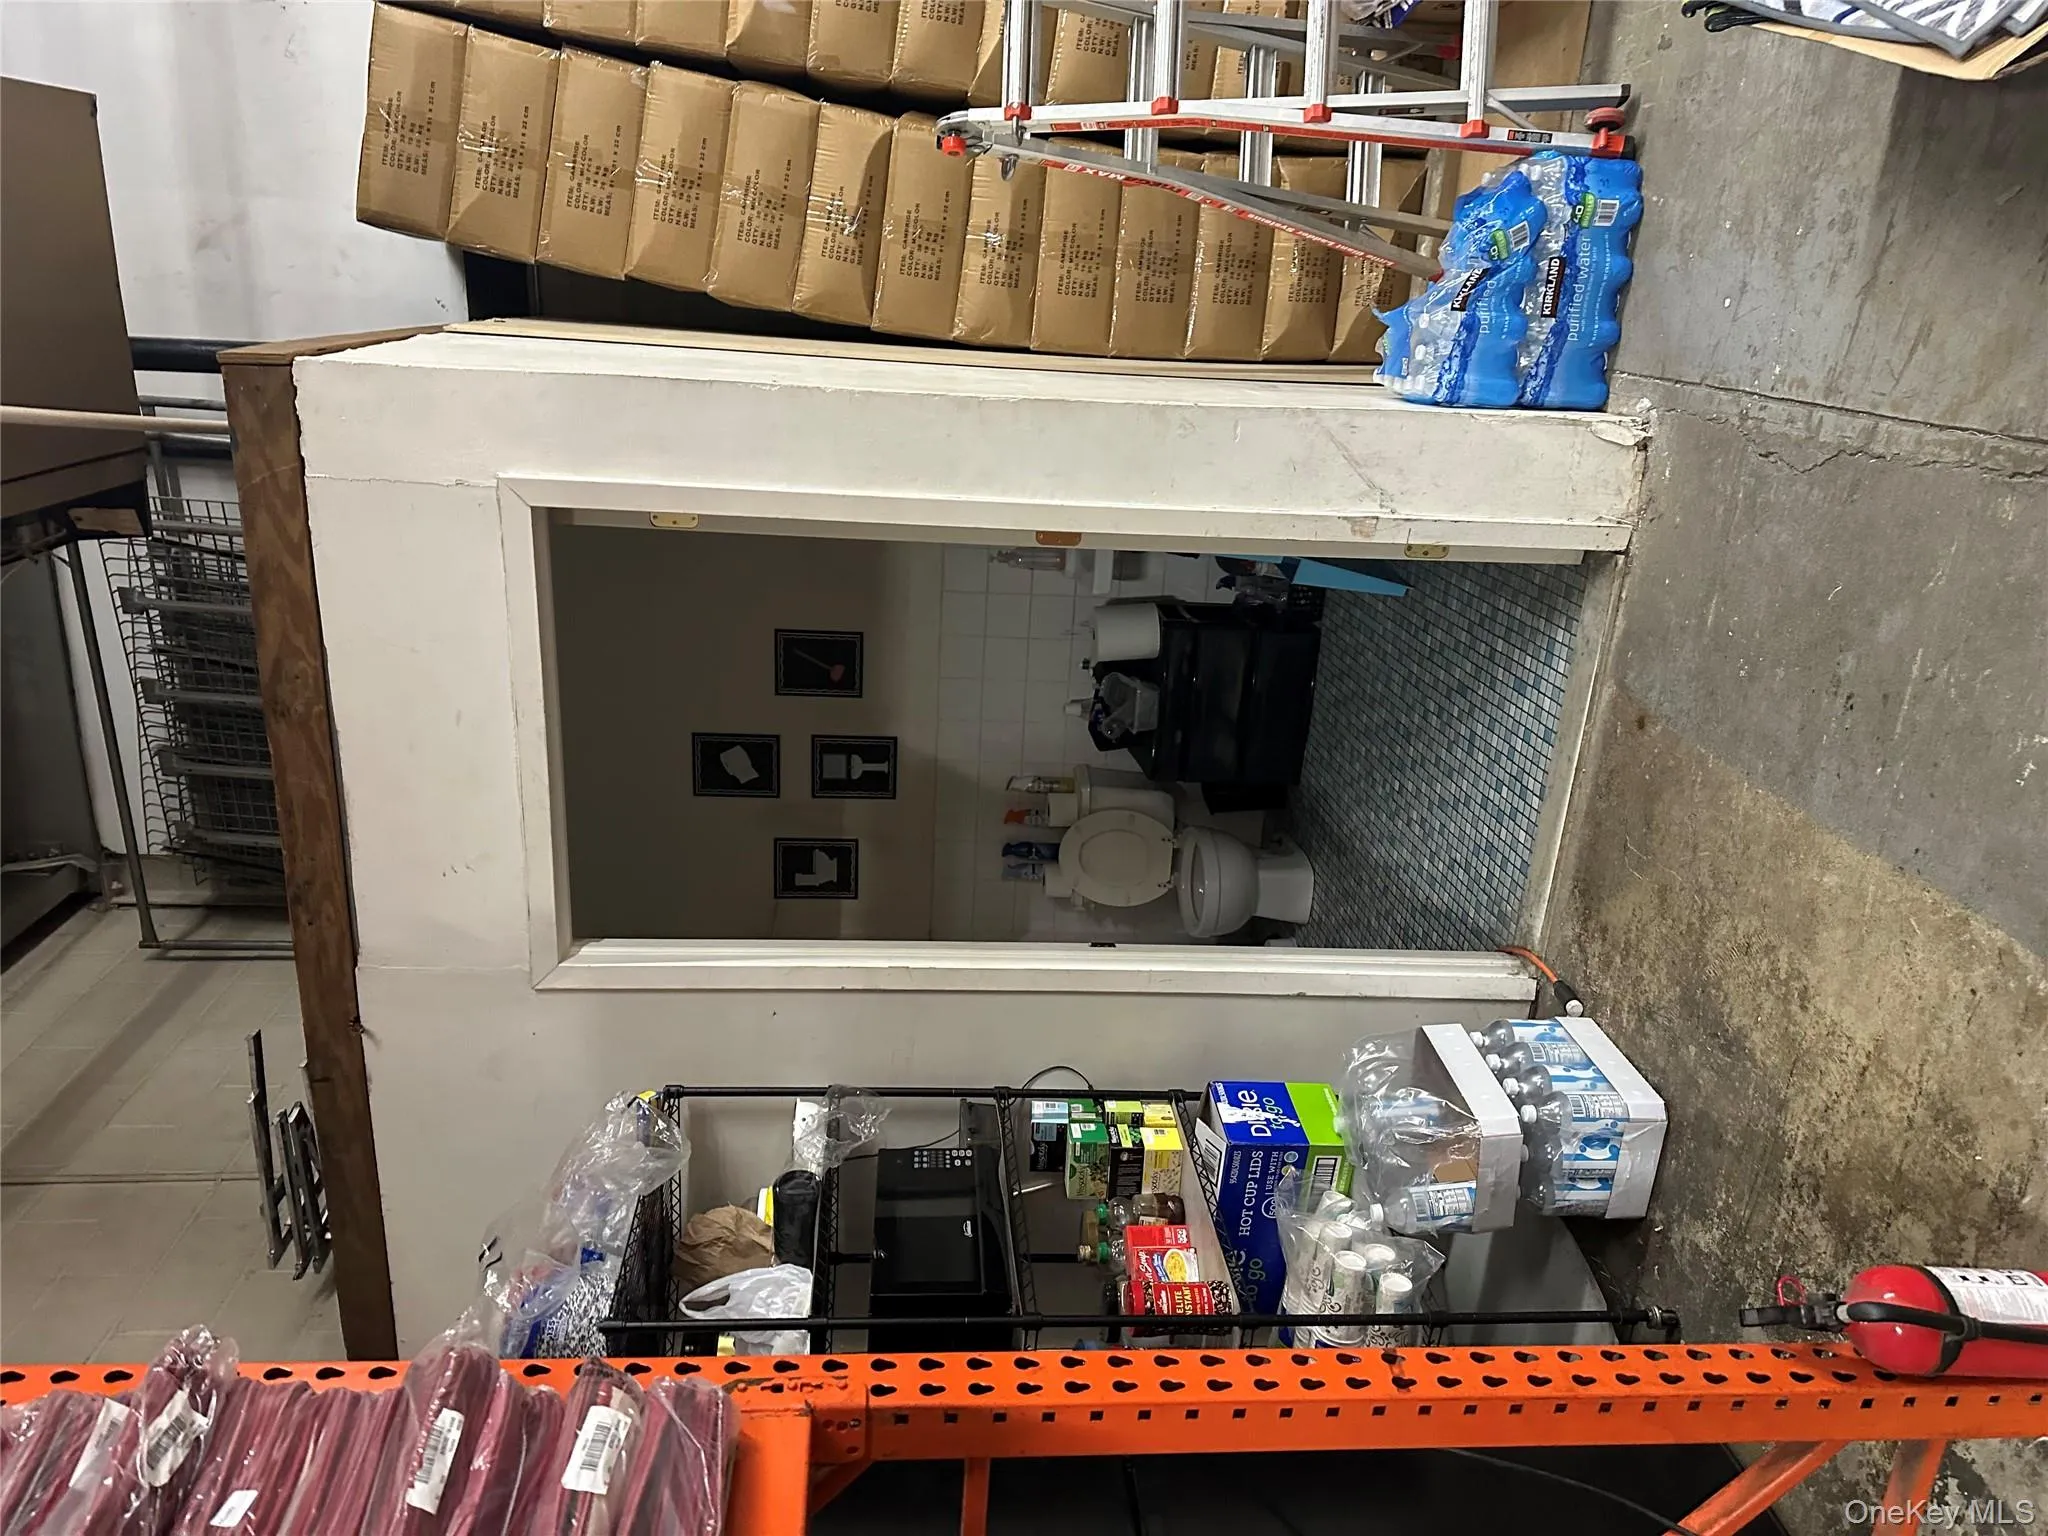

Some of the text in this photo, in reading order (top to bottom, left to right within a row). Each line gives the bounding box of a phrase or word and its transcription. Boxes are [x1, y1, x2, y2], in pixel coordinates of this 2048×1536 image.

[1543, 258, 1560, 315] KIRKLAND
[1566, 283, 1586, 341] purified
[1576, 236, 1592, 279] water
[1262, 1097, 1283, 1114] go
[1268, 1151, 1279, 1173] WITH
[1238, 1150, 1264, 1236] HOT CUP LIDS
[1265, 1175, 1275, 1190] USE
[1173, 1290, 1184, 1314] ELITE
